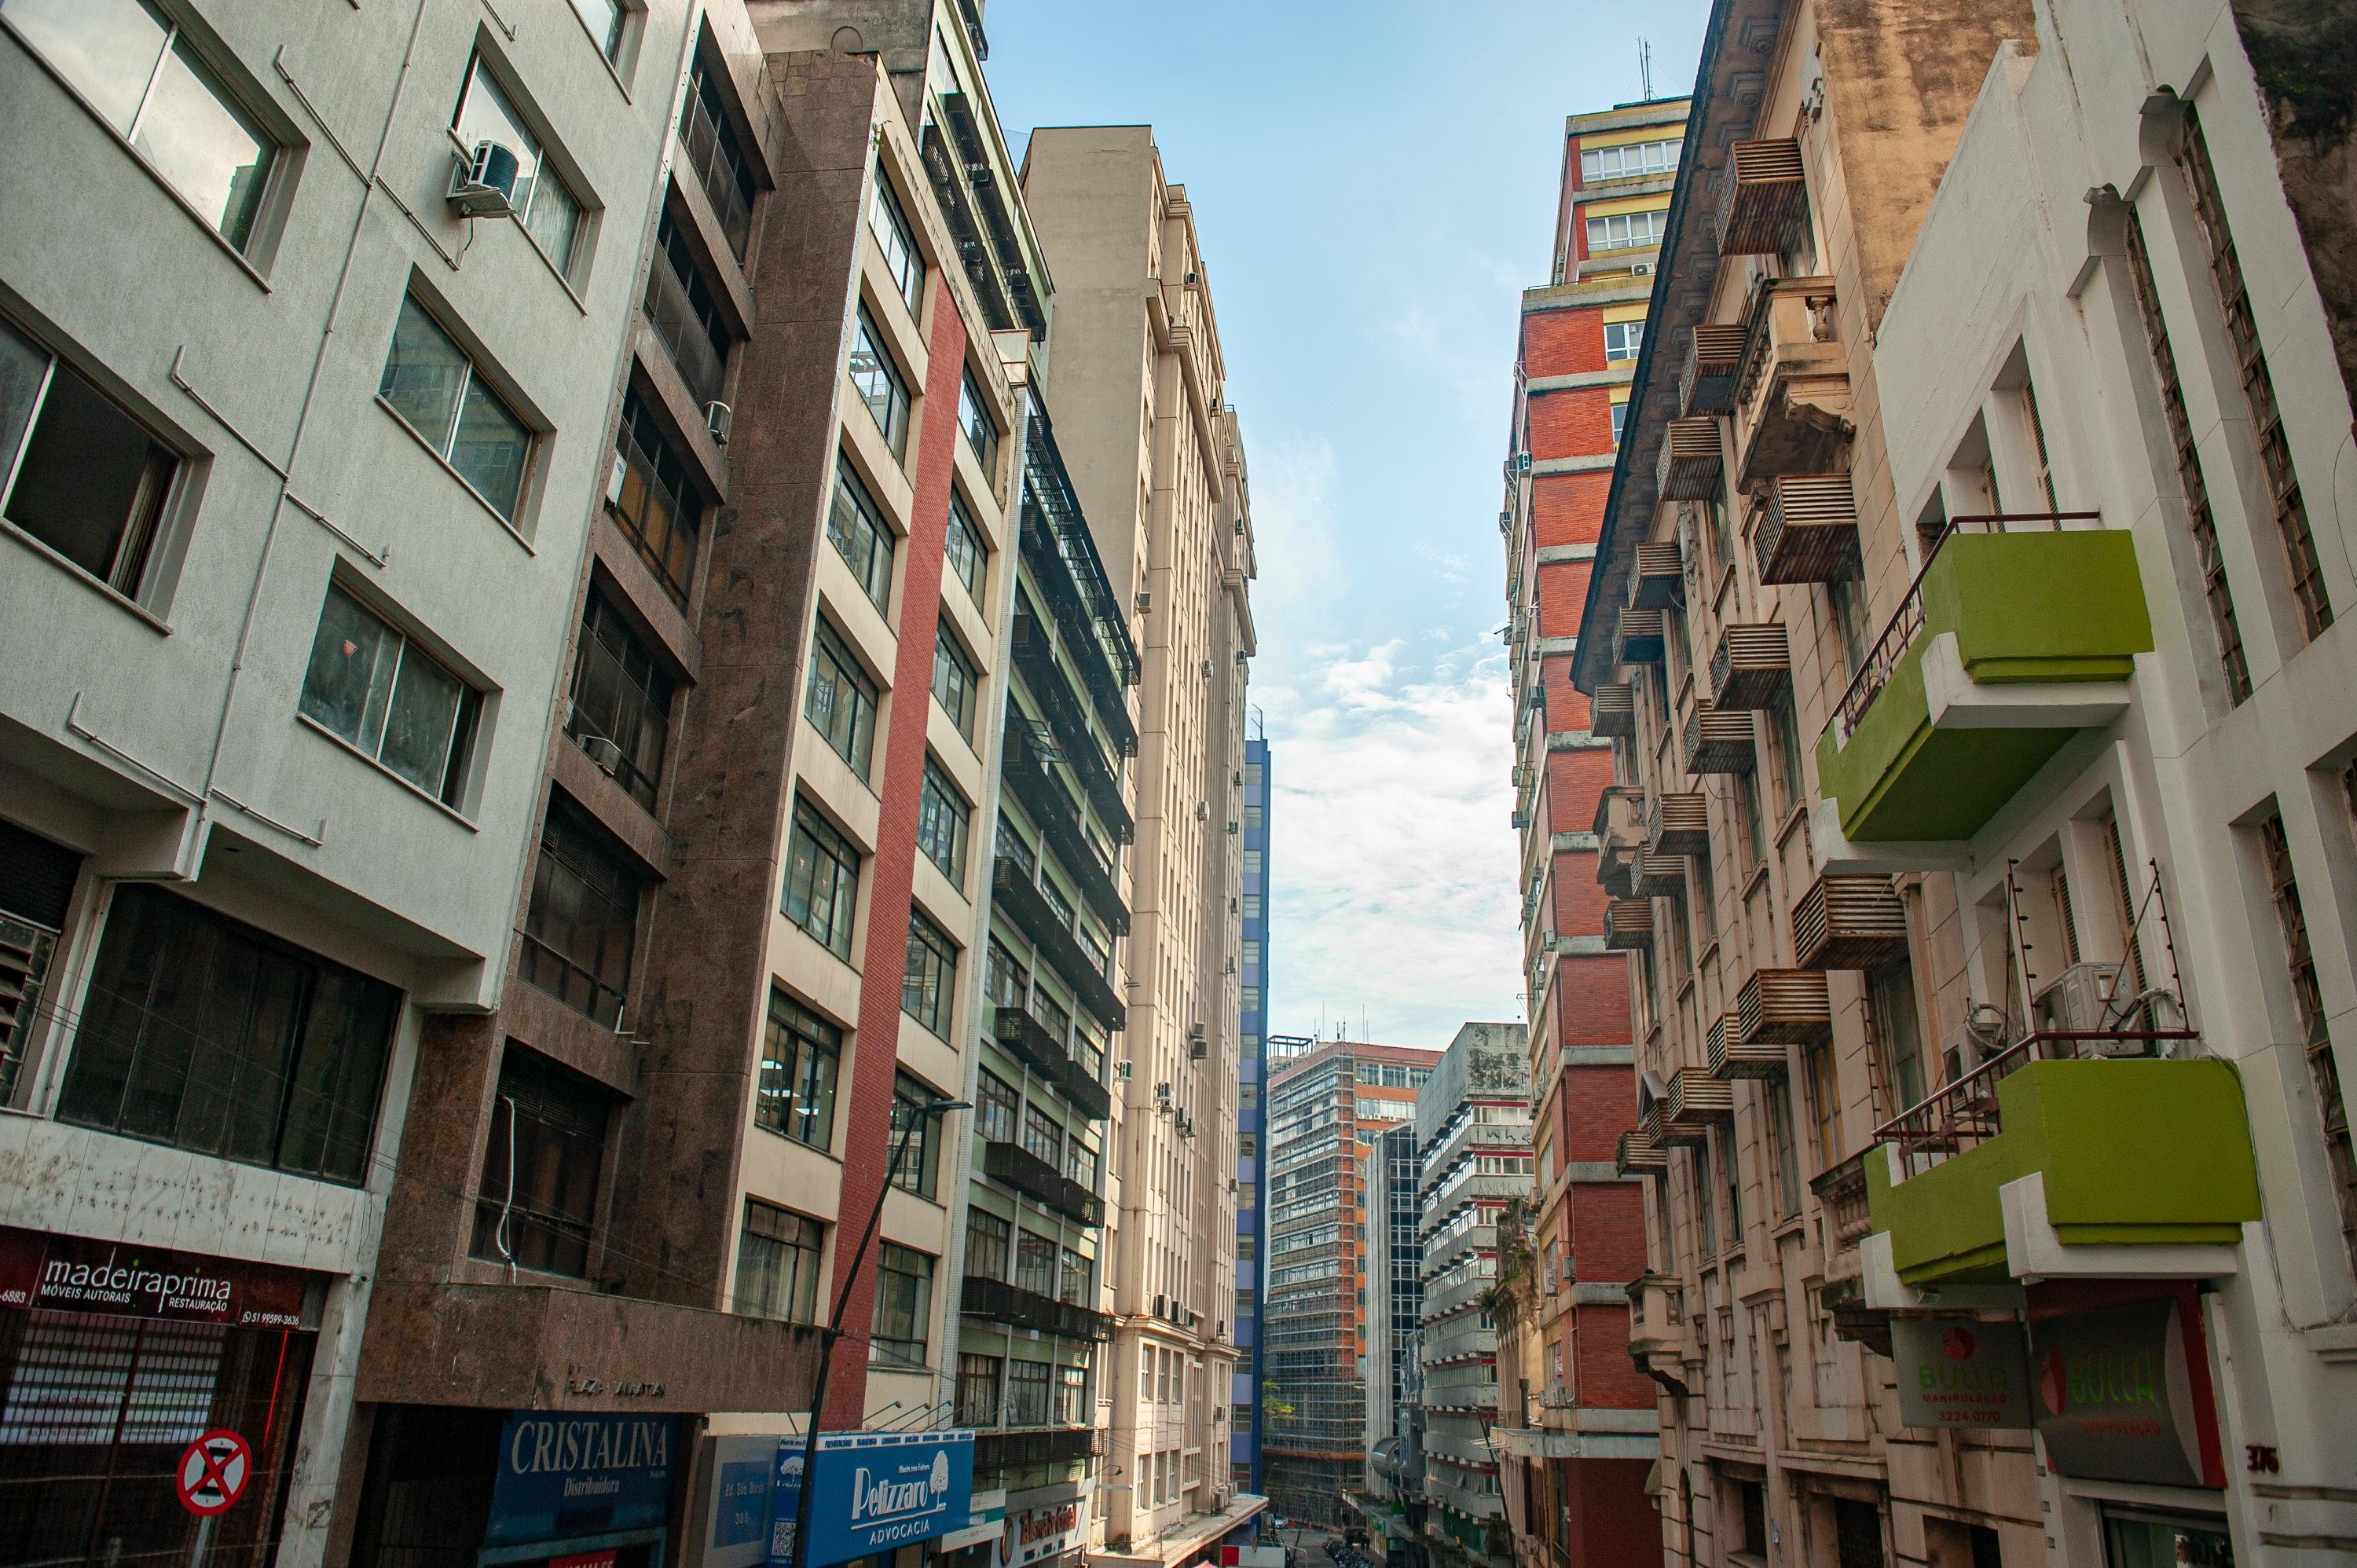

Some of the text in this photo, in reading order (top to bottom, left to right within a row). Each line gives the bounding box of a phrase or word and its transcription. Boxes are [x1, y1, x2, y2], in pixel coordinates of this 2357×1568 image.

[45, 1246, 231, 1313] madeiraprima
[41, 1284, 131, 1303] MÓVEIS AUTORAIS
[168, 1297, 228, 1313] RESTAURAÇÃO
[251, 1313, 300, 1325] 51 99599-3636
[1923, 1392, 2007, 1404] MANIPULAÇÃO
[1937, 1411, 2001, 1422] 3224.0770
[511, 1420, 667, 1475] CRISTALINA
[563, 1476, 620, 1497] Distribuidora
[852, 1467, 929, 1520] Pelizzaro
[869, 1519, 930, 1546] ADVOCACIA
